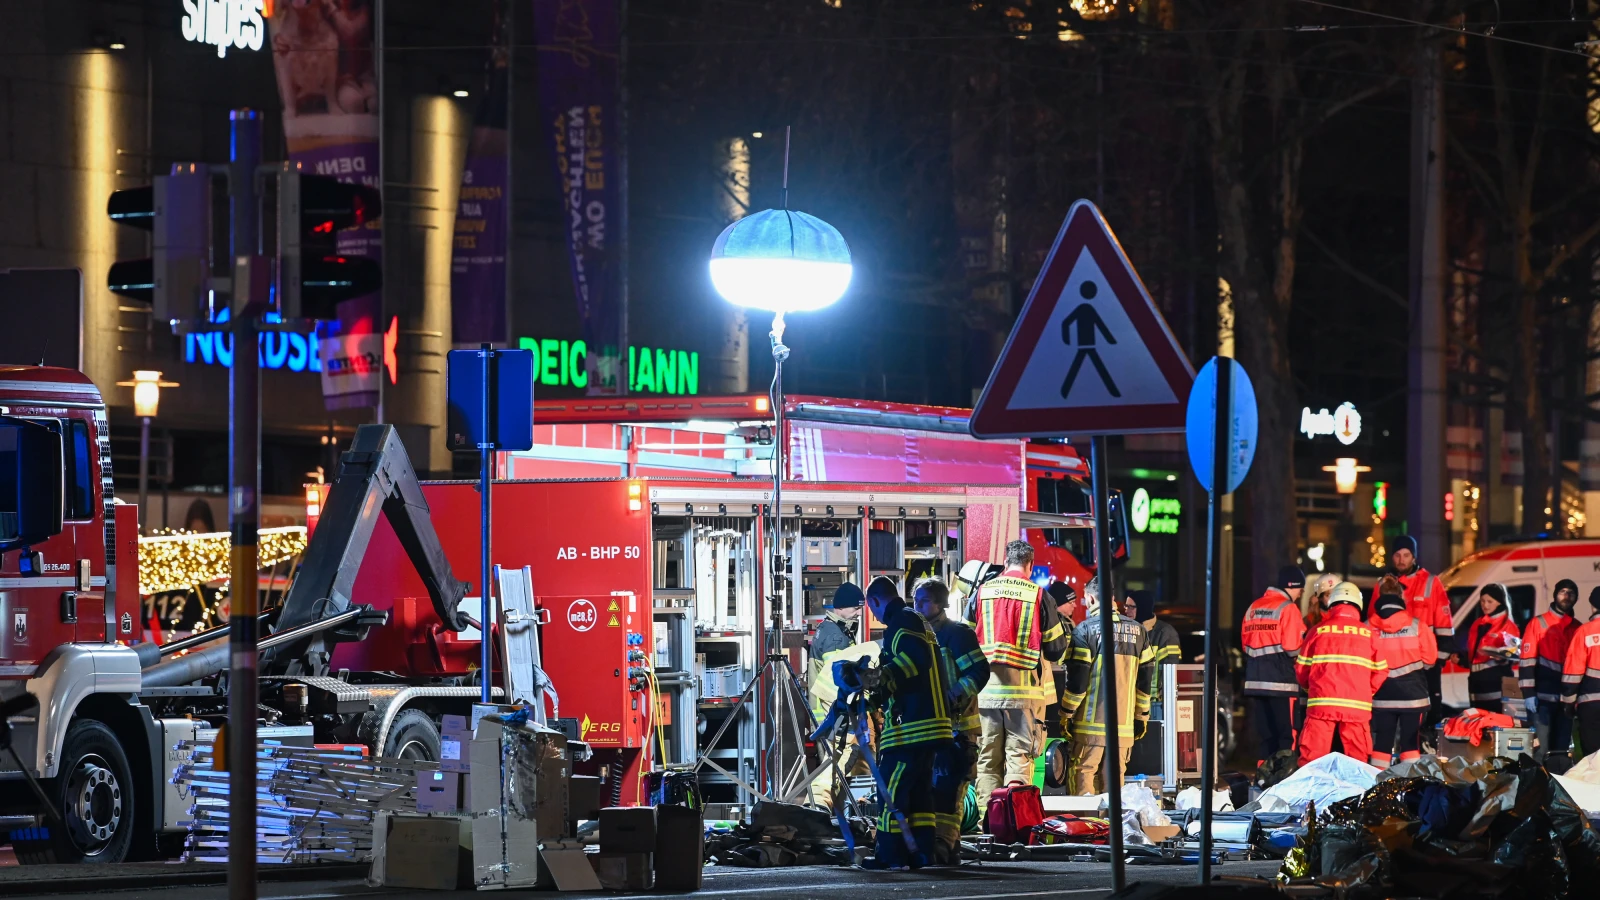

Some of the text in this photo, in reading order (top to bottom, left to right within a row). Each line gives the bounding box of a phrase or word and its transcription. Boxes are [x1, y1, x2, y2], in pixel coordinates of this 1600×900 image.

[519, 336, 699, 395] DEICANN
[556, 547, 578, 560] AB
[590, 546, 621, 559] BHP
[624, 545, 640, 559] 50
[144, 594, 186, 621] 112
[1090, 622, 1141, 636] FERWEHR
[1316, 624, 1371, 638] DLRG
